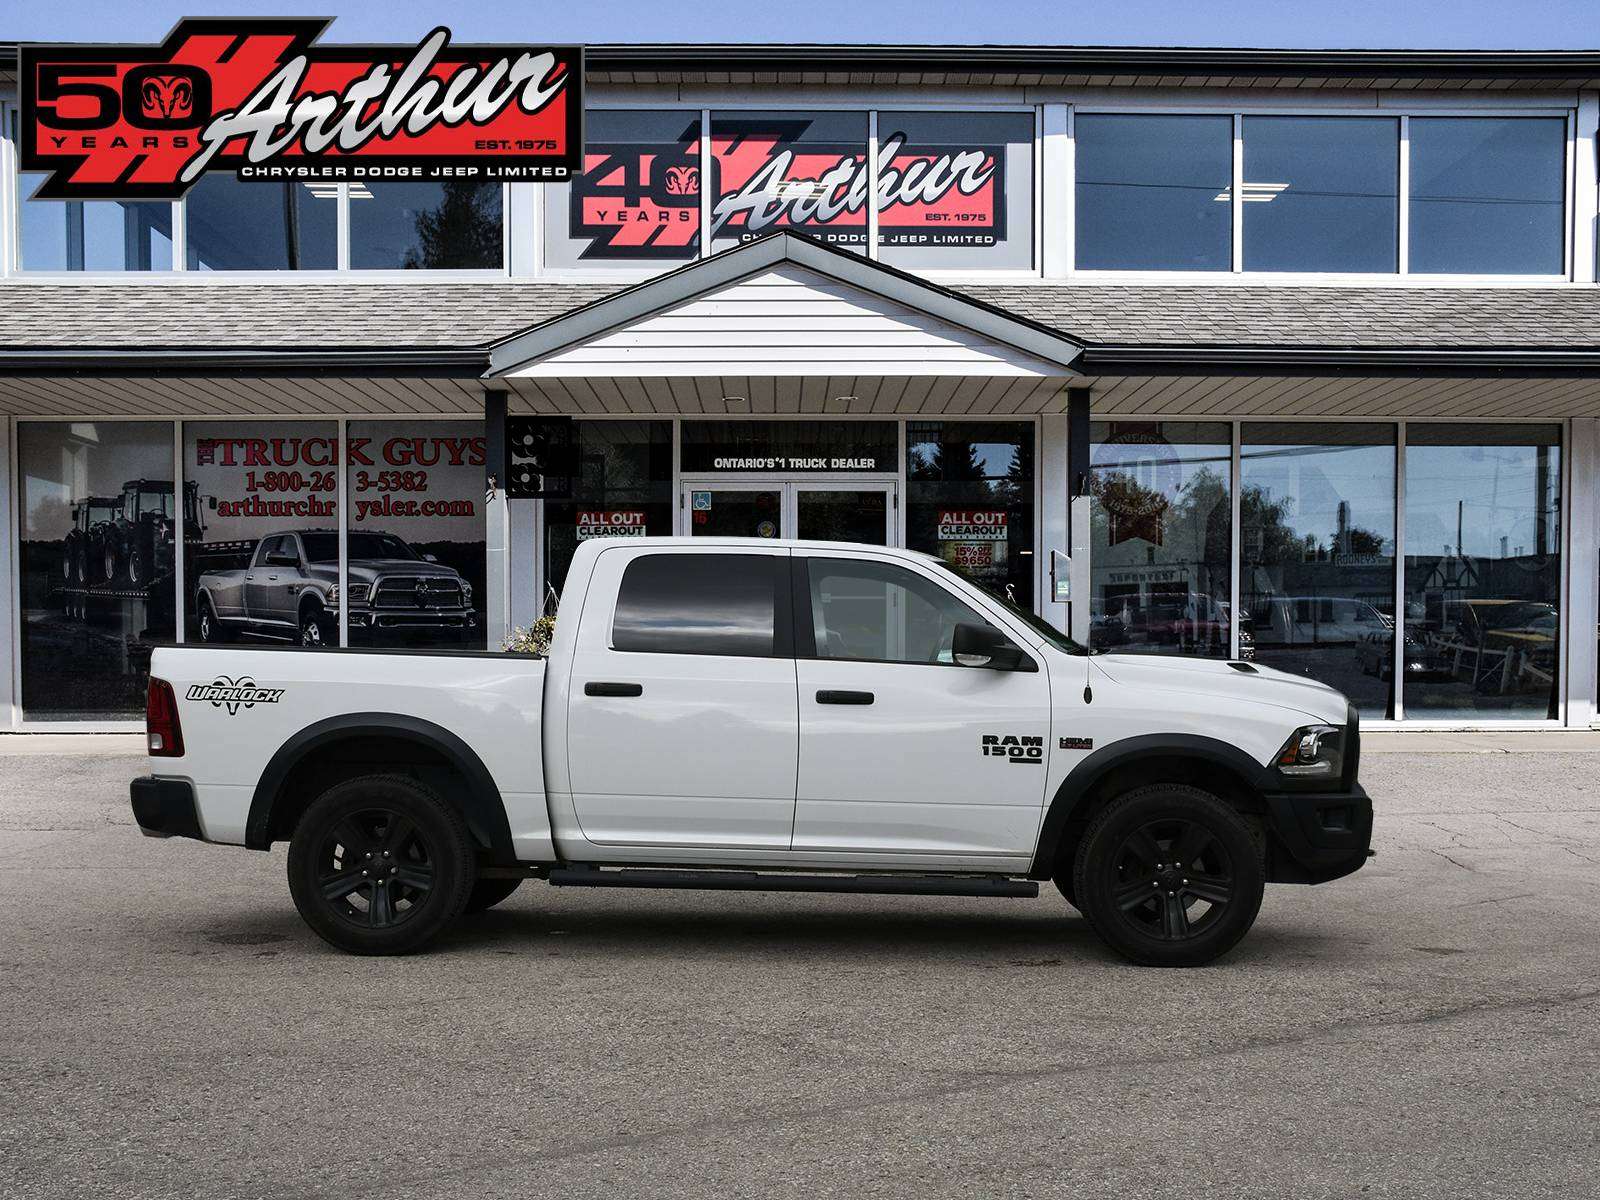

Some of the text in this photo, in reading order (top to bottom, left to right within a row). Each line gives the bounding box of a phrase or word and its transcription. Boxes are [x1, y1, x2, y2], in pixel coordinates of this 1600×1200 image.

[584, 150, 721, 208] 40
[711, 138, 998, 231] Arthur
[596, 210, 690, 222] YEARS
[925, 213, 986, 222] EST. 1975
[890, 235, 927, 243] JEEP
[933, 235, 994, 243] LIMITED
[212, 438, 375, 466] TRUCK
[382, 437, 486, 466] GUYS
[714, 457, 774, 469] ONTARIO'S
[788, 458, 827, 469] TRUCK
[831, 458, 876, 469] DEALER
[580, 512, 643, 525] ALL OUT
[941, 512, 1005, 524] ALL OUT
[579, 526, 644, 535] CLEAROUT
[941, 526, 1005, 535] CLEAROUT
[186, 684, 285, 703] WARLOCK
[982, 735, 1043, 746] RAM
[982, 746, 1043, 757] 1500
